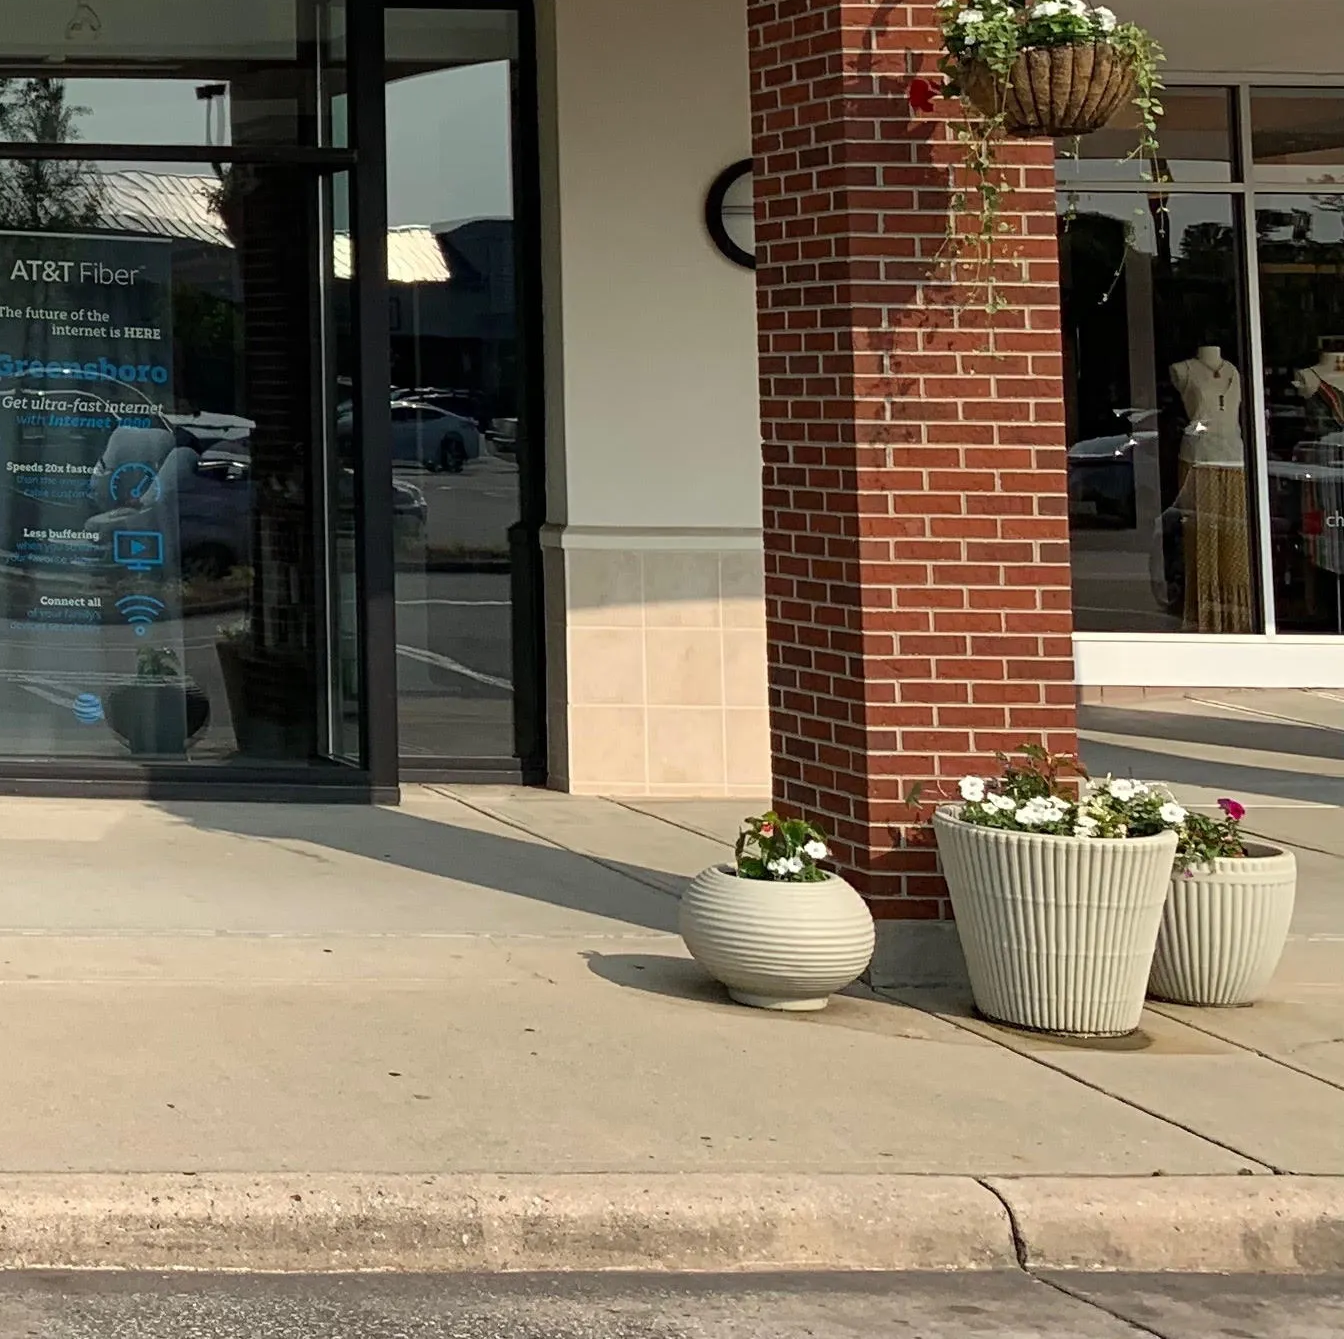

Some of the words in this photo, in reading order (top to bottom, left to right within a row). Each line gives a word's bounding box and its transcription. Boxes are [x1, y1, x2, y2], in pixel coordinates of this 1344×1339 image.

[10, 259, 74, 282] AT&T
[80, 262, 139, 285] Fiber
[25, 306, 68, 320] future
[70, 309, 85, 321] of
[87, 310, 110, 322] the
[52, 324, 106, 337] internet
[110, 327, 121, 338] is
[124, 327, 161, 340] HERE
[2, 396, 28, 409] Get
[31, 397, 102, 413] ultra-fast
[104, 400, 164, 416] internet
[48, 414, 112, 428] Internet
[6, 461, 43, 473] Speeds
[44, 463, 64, 473] 20x
[66, 463, 97, 474] faster
[23, 528, 47, 538] Less
[48, 528, 100, 541] buffering
[40, 595, 85, 606] Connect
[87, 597, 102, 607] all
